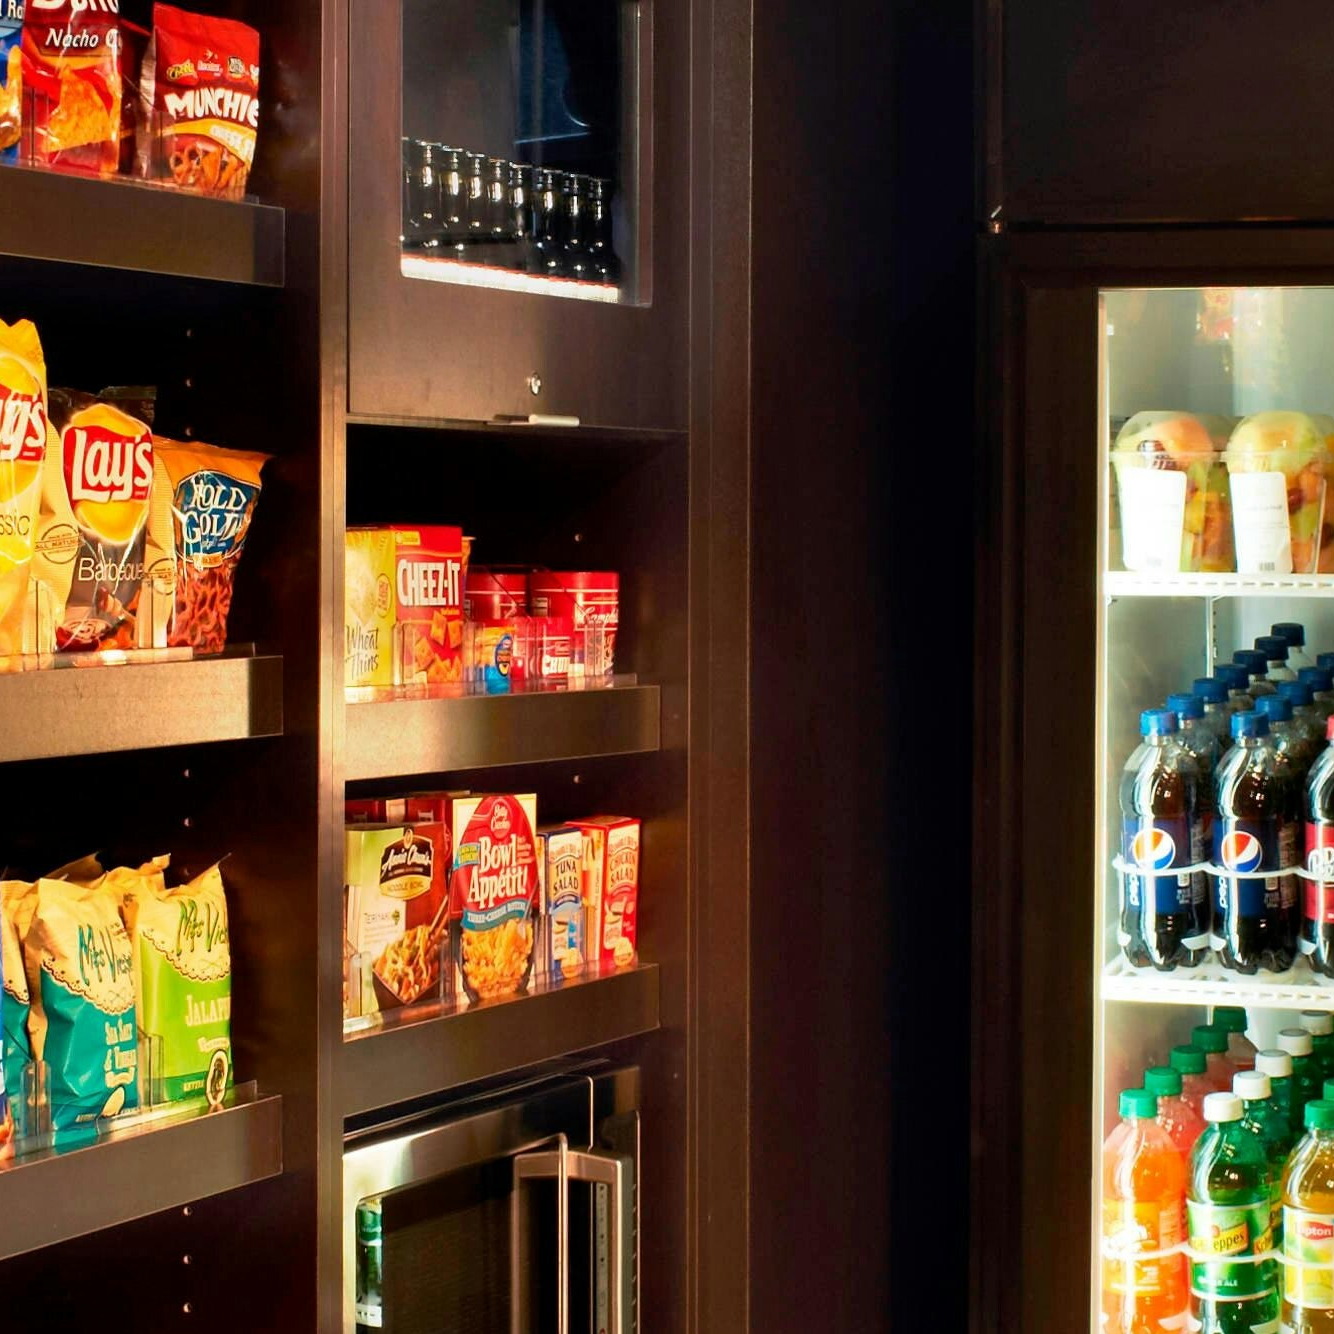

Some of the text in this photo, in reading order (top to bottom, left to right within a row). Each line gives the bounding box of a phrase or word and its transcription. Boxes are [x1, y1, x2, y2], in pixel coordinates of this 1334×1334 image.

[46, 28, 99, 48] Nacho
[72, 427, 153, 504] Lay's
[397, 558, 460, 606] CHEEZ-IT
[479, 833, 516, 873] Bowl
[555, 859, 577, 877] TUNA
[553, 875, 579, 896] SALAD
